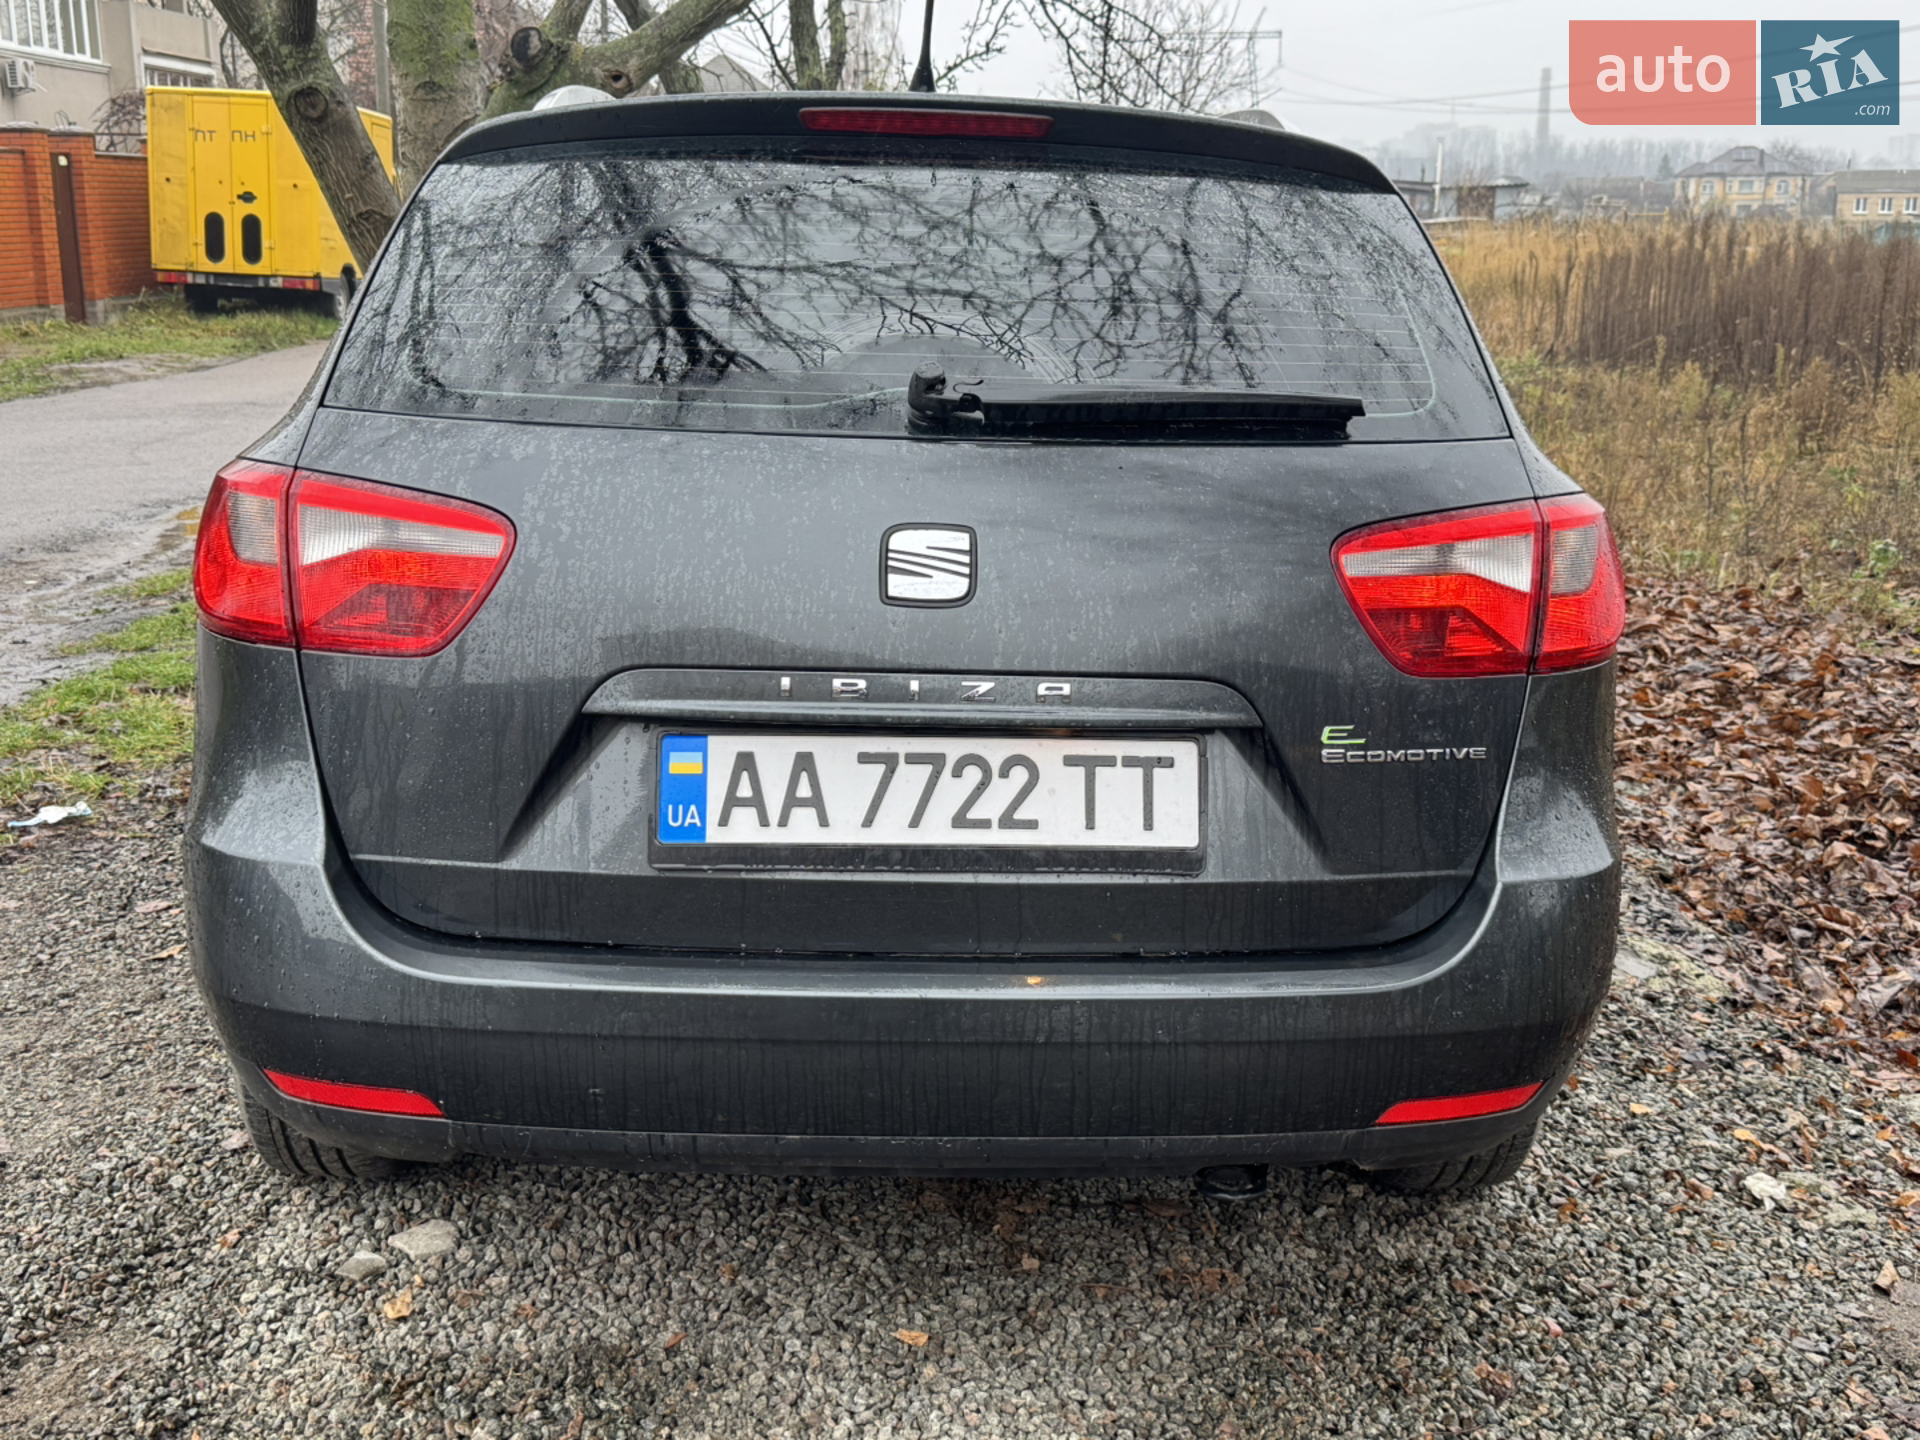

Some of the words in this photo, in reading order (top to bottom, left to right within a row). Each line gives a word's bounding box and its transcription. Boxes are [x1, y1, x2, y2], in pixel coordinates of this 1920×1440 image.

[231, 130, 256, 142] ПН
[780, 676, 1072, 703] IBIZA
[717, 751, 830, 828] AA
[857, 751, 1040, 830] 7722
[1063, 755, 1175, 831] TT
[667, 804, 702, 827] UA
